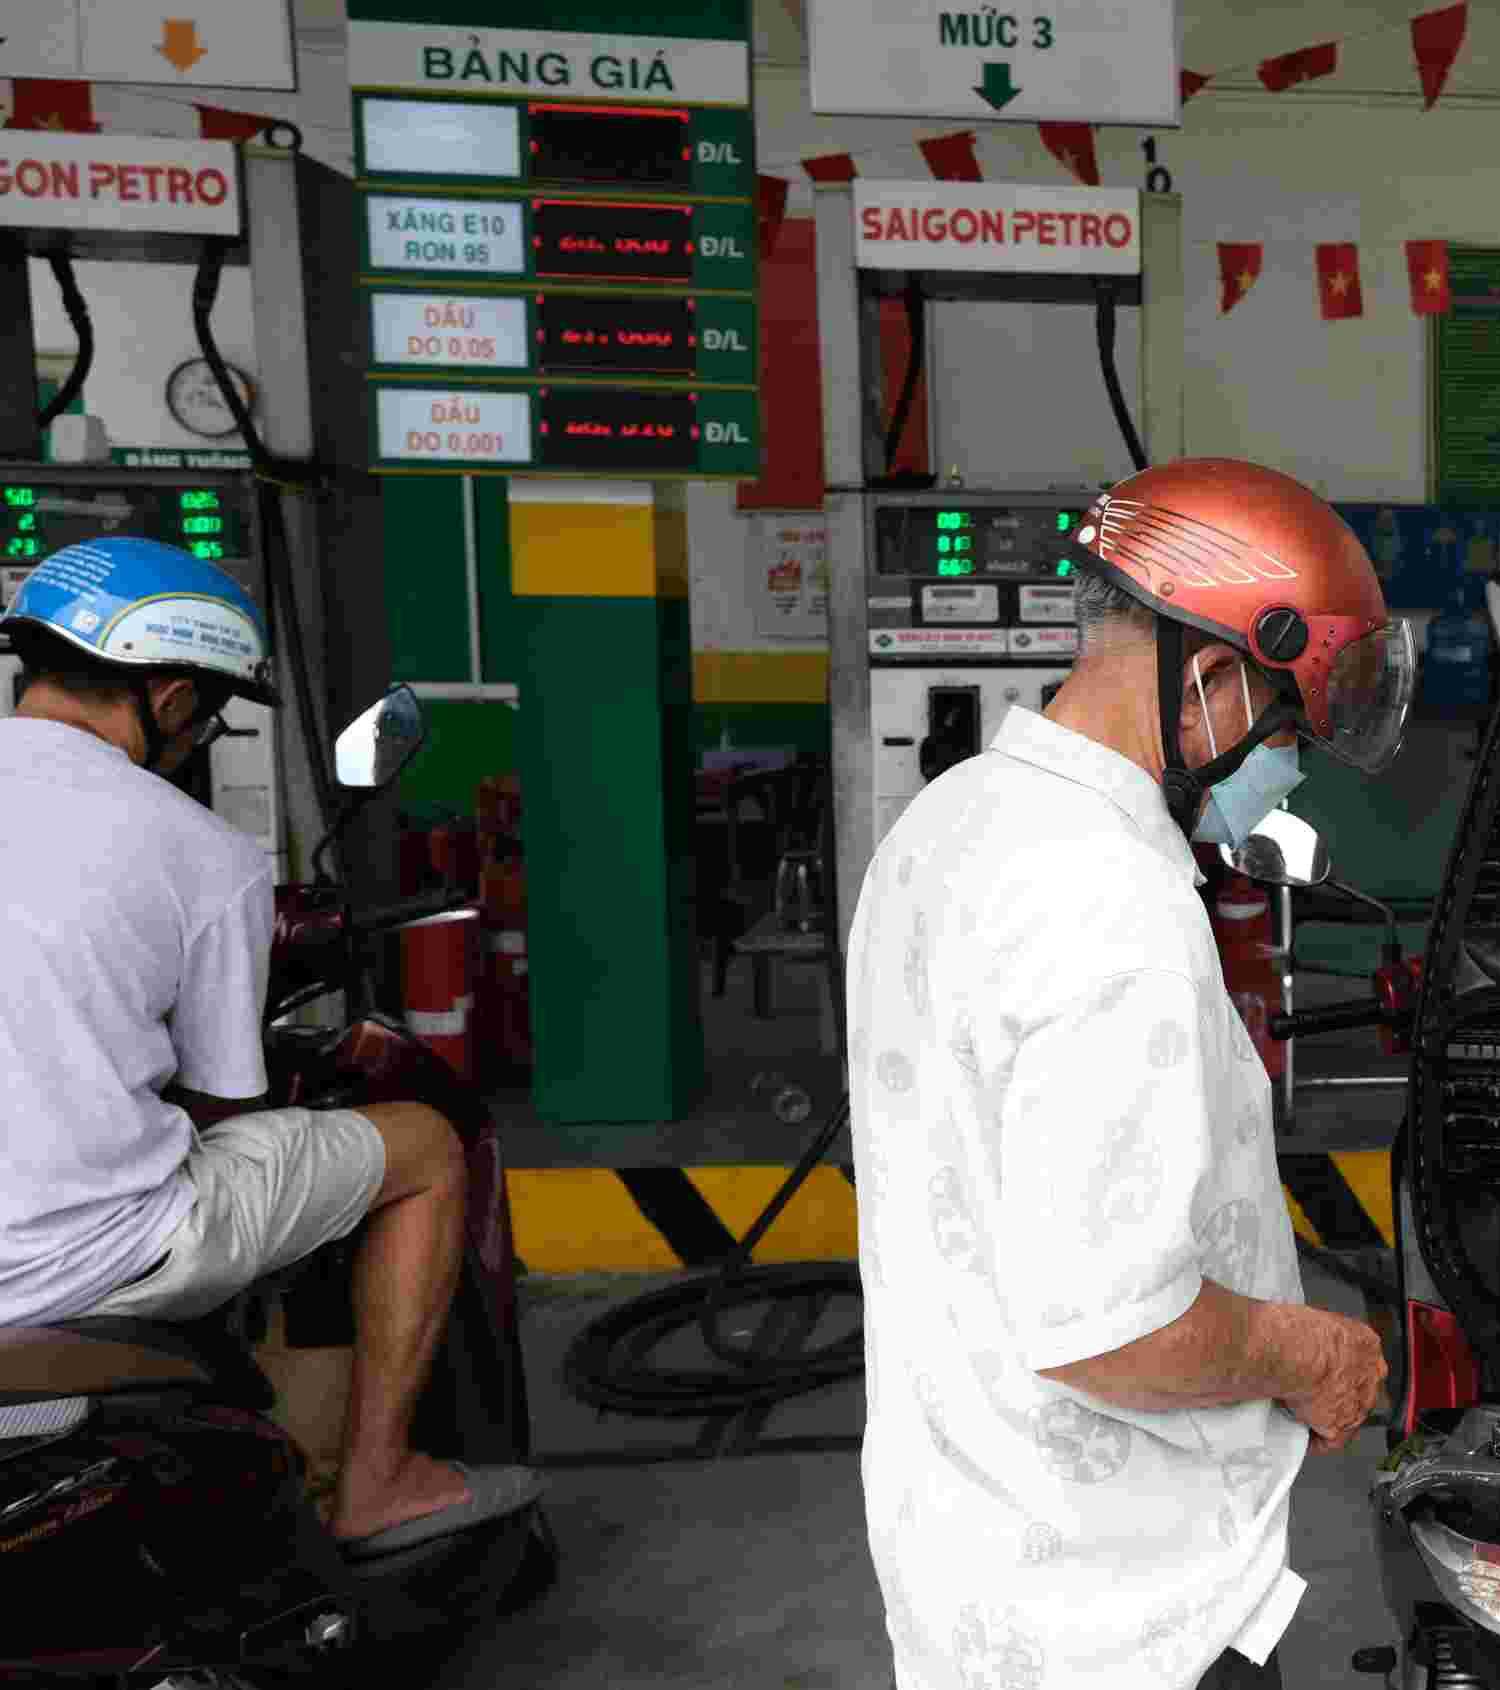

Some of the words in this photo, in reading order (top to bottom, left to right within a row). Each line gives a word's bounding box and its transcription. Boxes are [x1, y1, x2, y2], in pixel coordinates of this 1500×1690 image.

[940, 3, 1018, 48] MỨC
[1032, 16, 1054, 49] 3
[423, 34, 570, 87] BẢNG
[590, 49, 675, 92] GIÁ
[698, 141, 742, 165] Đ/L
[88, 161, 229, 206] PETRO
[463, 211, 506, 237] E10
[861, 206, 1003, 244] SAIGON
[1012, 211, 1132, 249] PETRO
[404, 240, 456, 262] RON
[463, 243, 489, 265] 95
[700, 237, 744, 260] Đ/L
[703, 329, 748, 352] Đ/L
[705, 422, 749, 445] Đ/L
